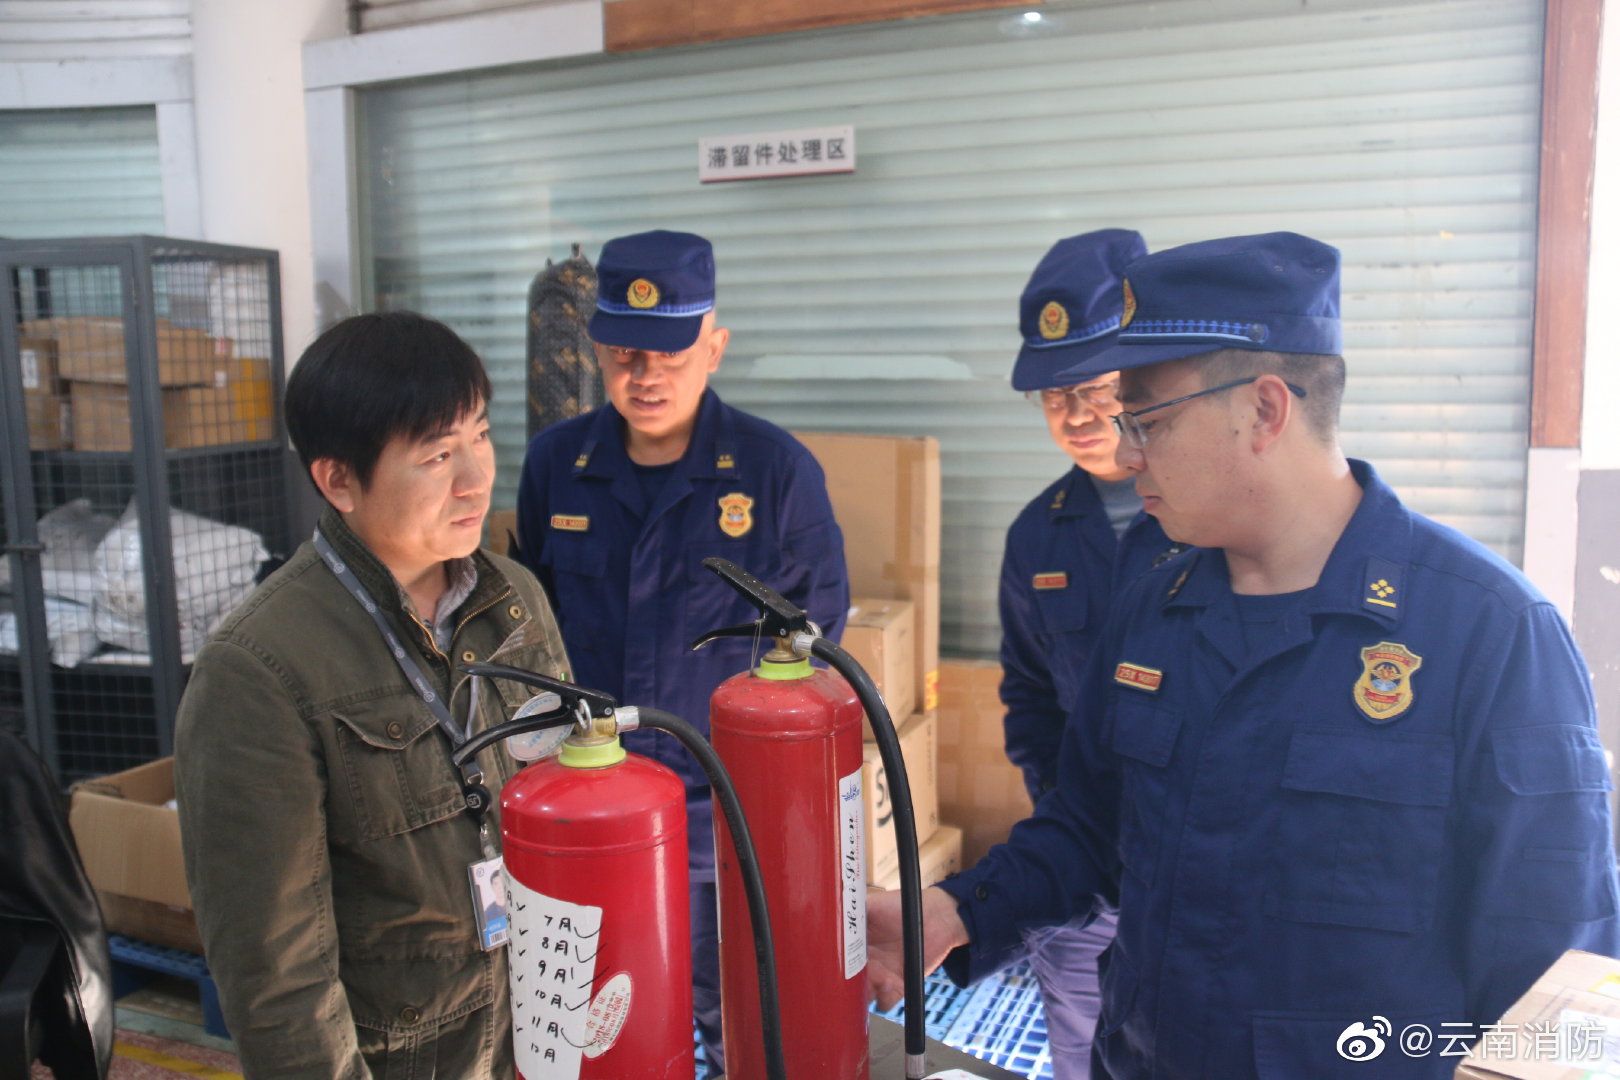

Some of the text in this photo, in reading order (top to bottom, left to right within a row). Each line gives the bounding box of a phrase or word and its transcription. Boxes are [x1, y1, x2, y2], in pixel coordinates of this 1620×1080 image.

[707, 137, 846, 168] 滞留件处理区
